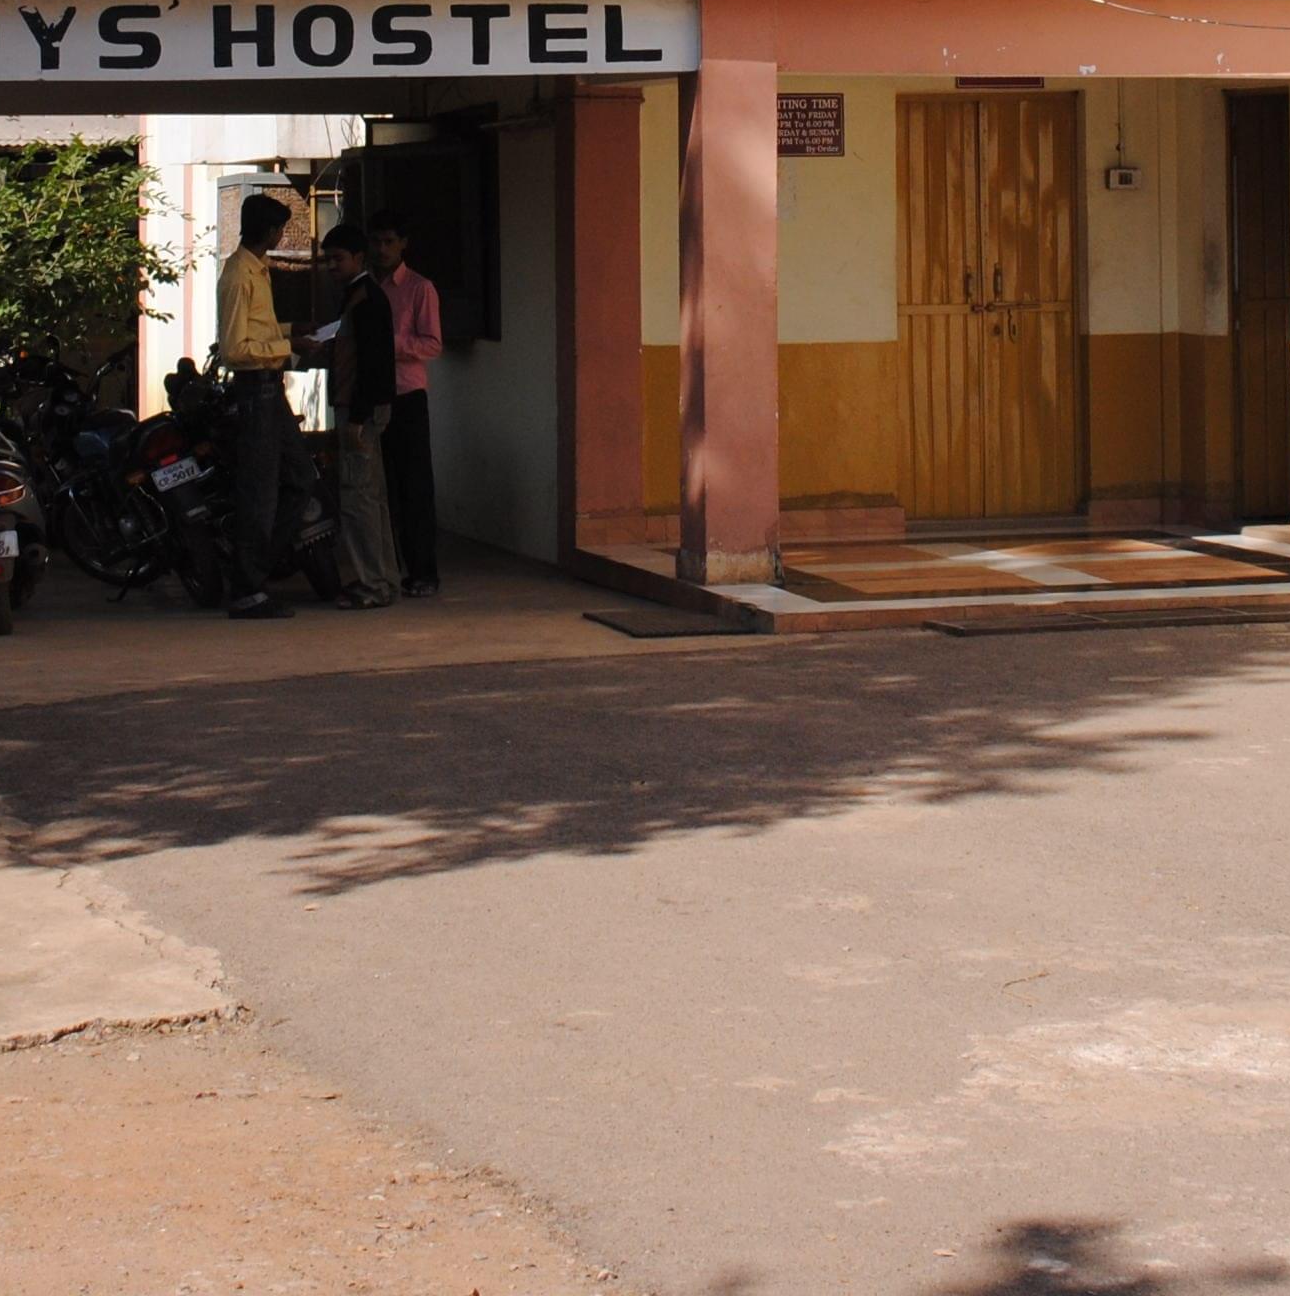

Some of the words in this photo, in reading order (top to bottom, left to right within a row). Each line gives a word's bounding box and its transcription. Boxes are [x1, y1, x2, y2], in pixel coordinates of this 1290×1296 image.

[213, 3, 663, 67] HOSTEL
[777, 99, 807, 109] ITING
[811, 99, 838, 109] TIME
[777, 111, 793, 119] DAY
[809, 111, 837, 119] FRIDAY
[809, 128, 840, 136] SUNDAY
[817, 144, 839, 153] Order
